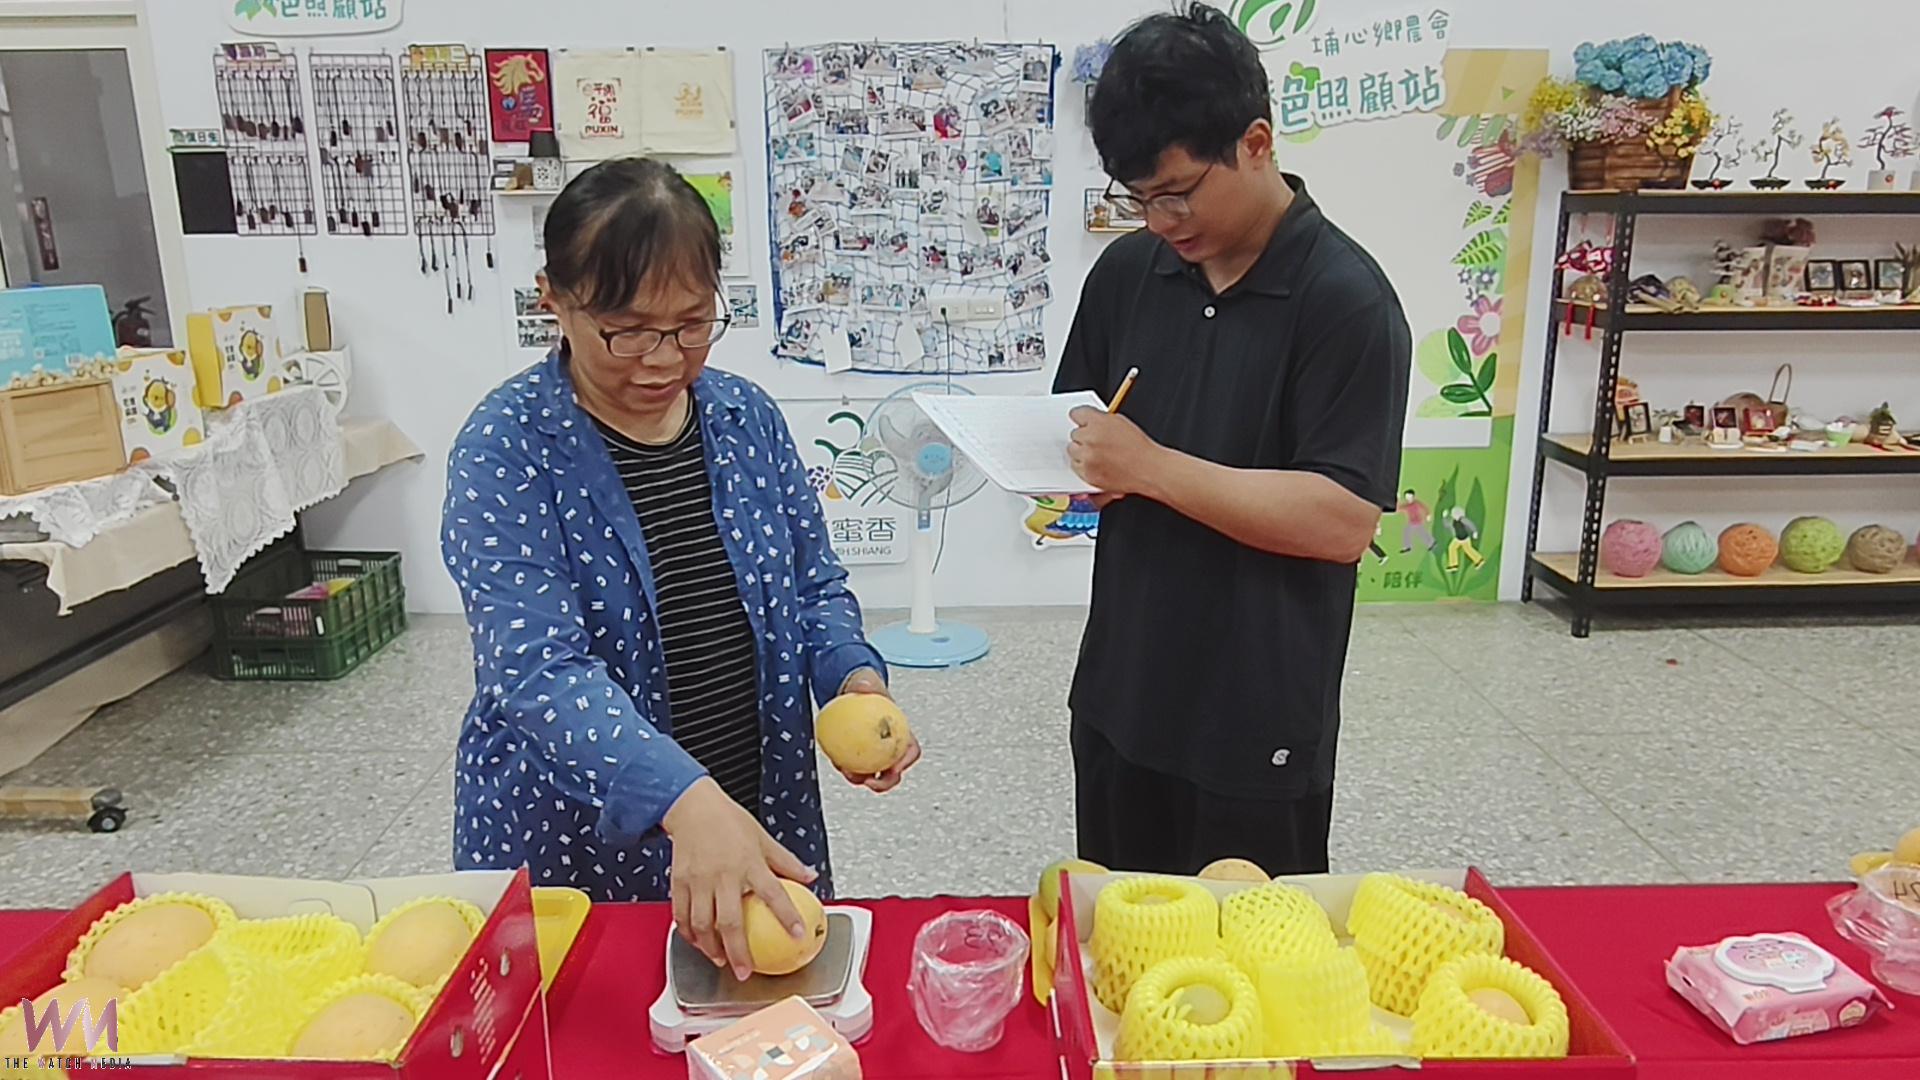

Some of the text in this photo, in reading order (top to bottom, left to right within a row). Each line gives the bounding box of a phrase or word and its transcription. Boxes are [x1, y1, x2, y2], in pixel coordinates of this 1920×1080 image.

[1268, 66, 1440, 127] 色照顧站
[585, 125, 618, 134] PUXIN
